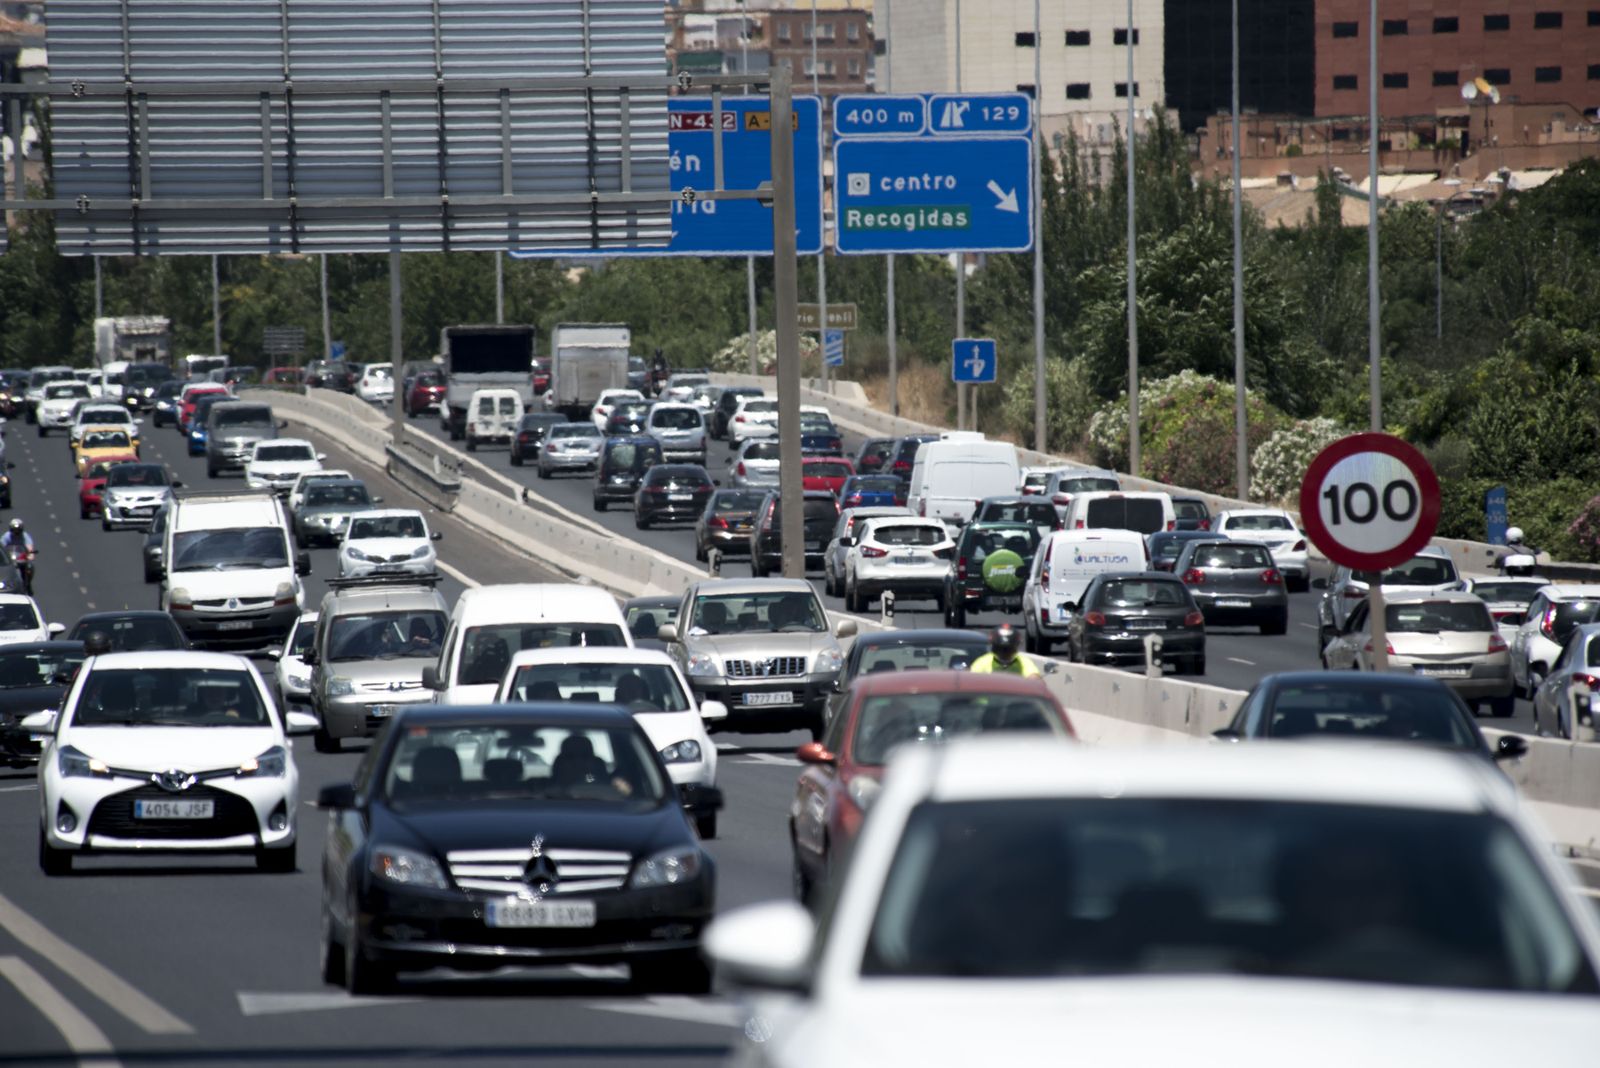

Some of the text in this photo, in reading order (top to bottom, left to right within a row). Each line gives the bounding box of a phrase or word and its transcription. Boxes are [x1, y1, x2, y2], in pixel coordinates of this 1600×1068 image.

[846, 108, 915, 124] 400 m
[982, 106, 1020, 122] 129
[669, 150, 701, 172] én
[880, 173, 957, 191] centro
[847, 209, 968, 232] Recogidas
[1323, 479, 1419, 526] 100
[145, 803, 211, 817] 4054 JSF
